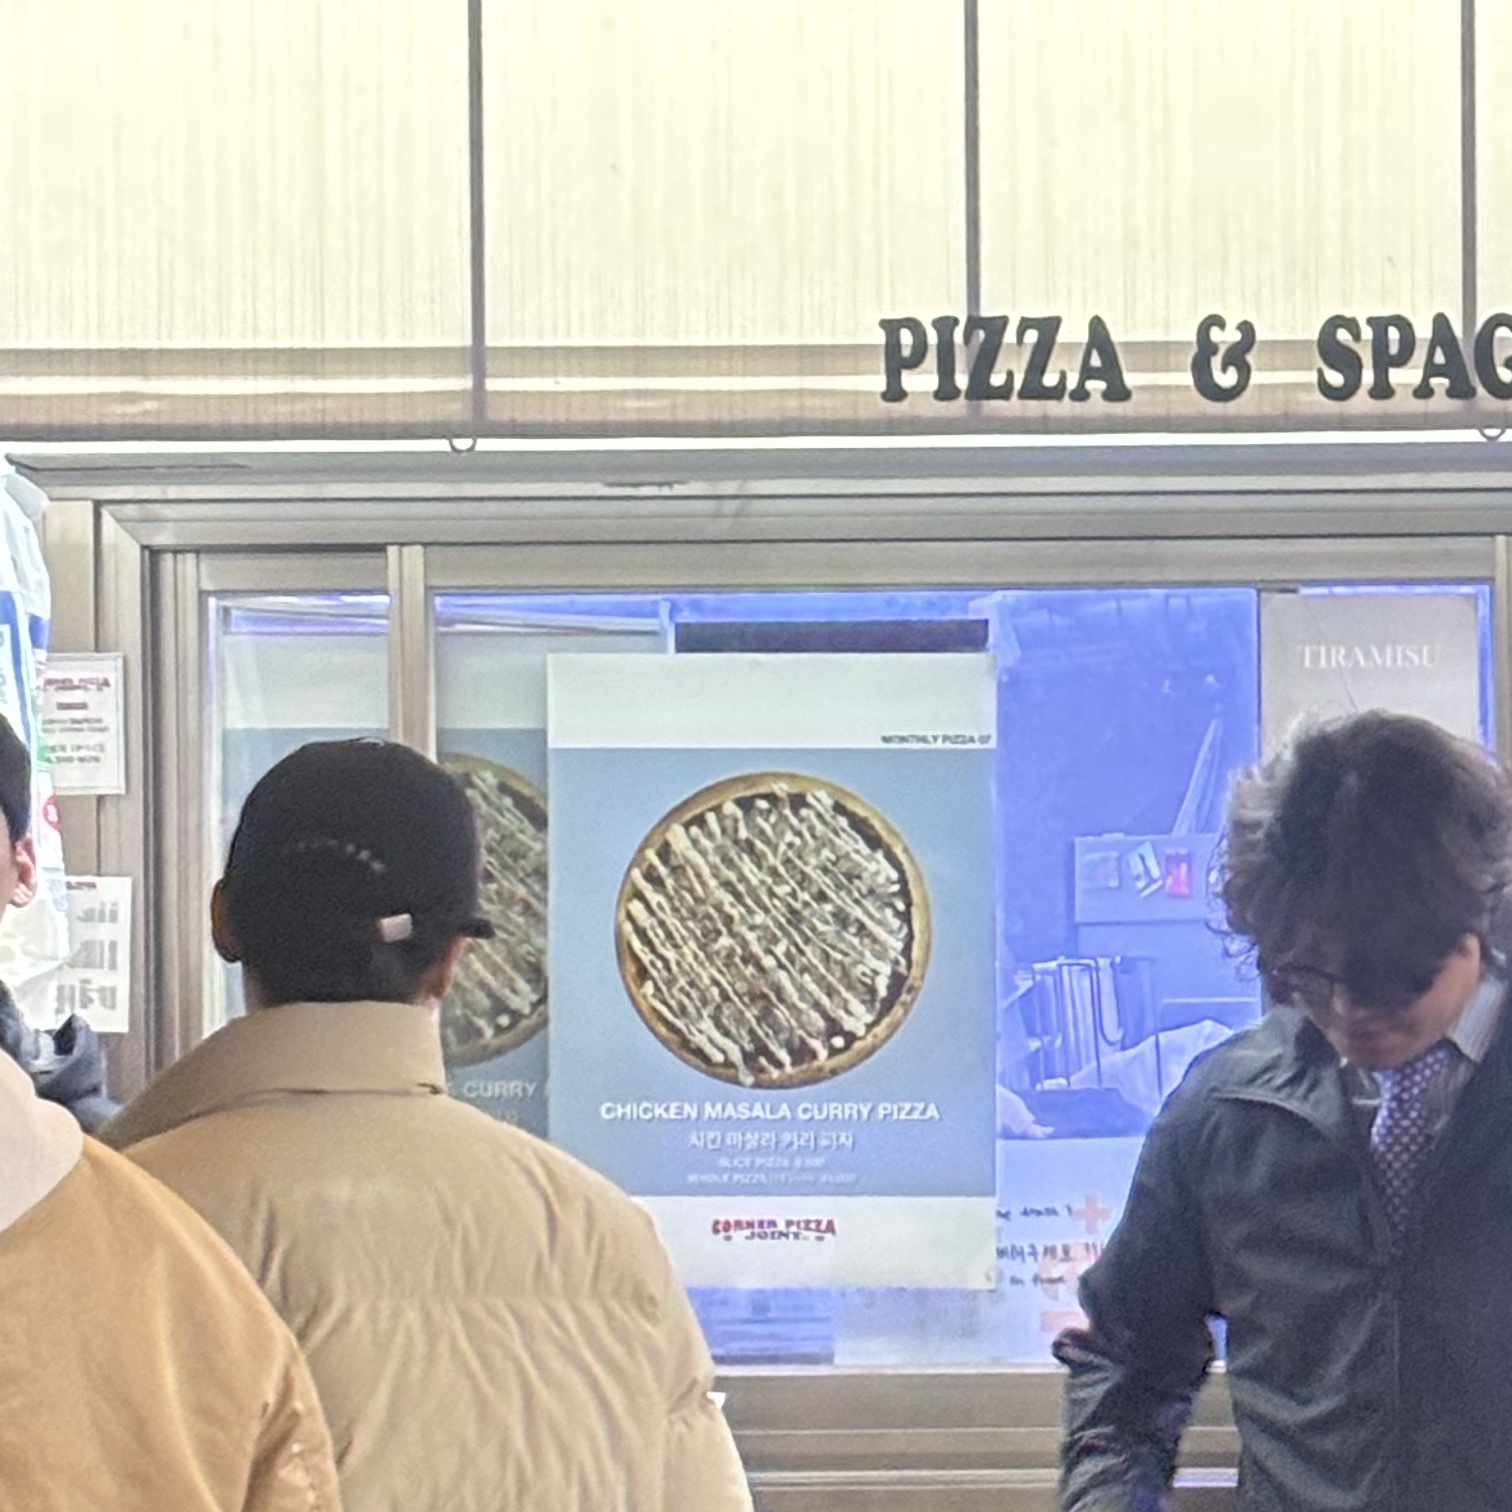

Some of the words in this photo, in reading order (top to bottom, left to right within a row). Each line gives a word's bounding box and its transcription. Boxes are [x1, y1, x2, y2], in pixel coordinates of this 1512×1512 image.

[880, 314, 1131, 402] PIZZA
[1192, 314, 1256, 401] &
[1297, 644, 1441, 668] TIRAMISU
[463, 1080, 537, 1099] CURRY
[600, 1101, 699, 1121] CHICKEN
[703, 1101, 792, 1121] MASALA
[797, 1101, 872, 1121] CURRY
[877, 1101, 941, 1121] PIZZA
[784, 1218, 837, 1237] PIZZA
